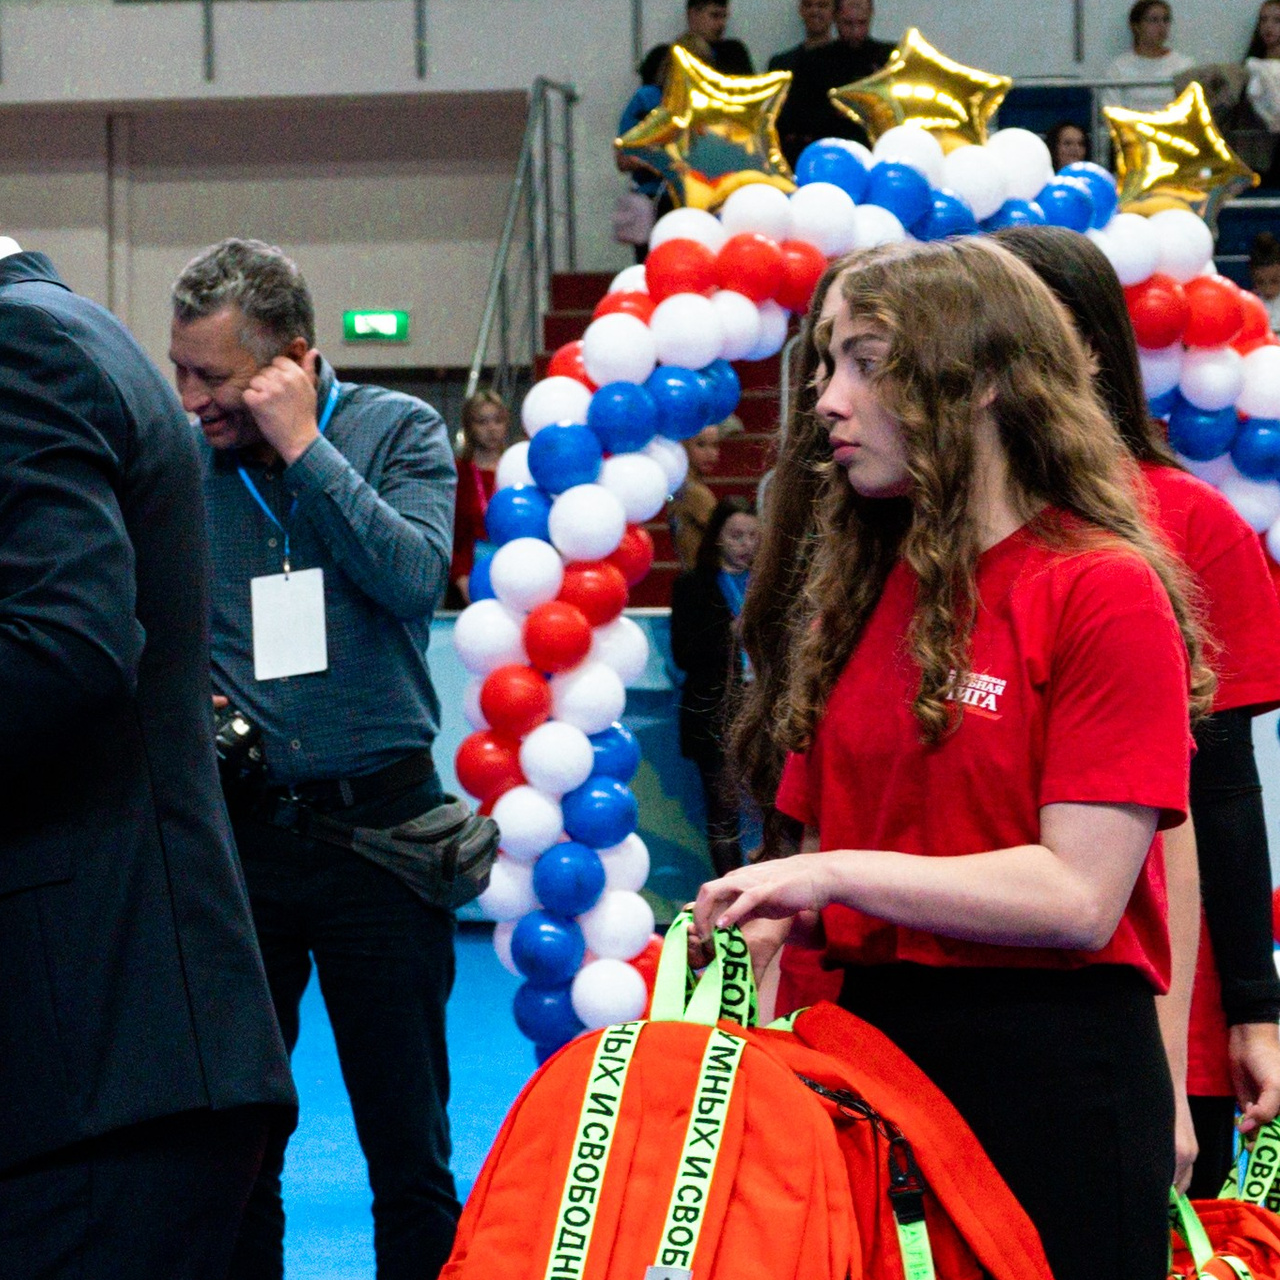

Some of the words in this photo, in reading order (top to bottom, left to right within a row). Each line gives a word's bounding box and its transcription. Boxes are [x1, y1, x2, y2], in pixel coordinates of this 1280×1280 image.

[586, 1092, 618, 1117] И
[688, 1030, 740, 1150] УМНЫХ
[681, 1155, 712, 1179] И
[1244, 1145, 1278, 1204] СВО
